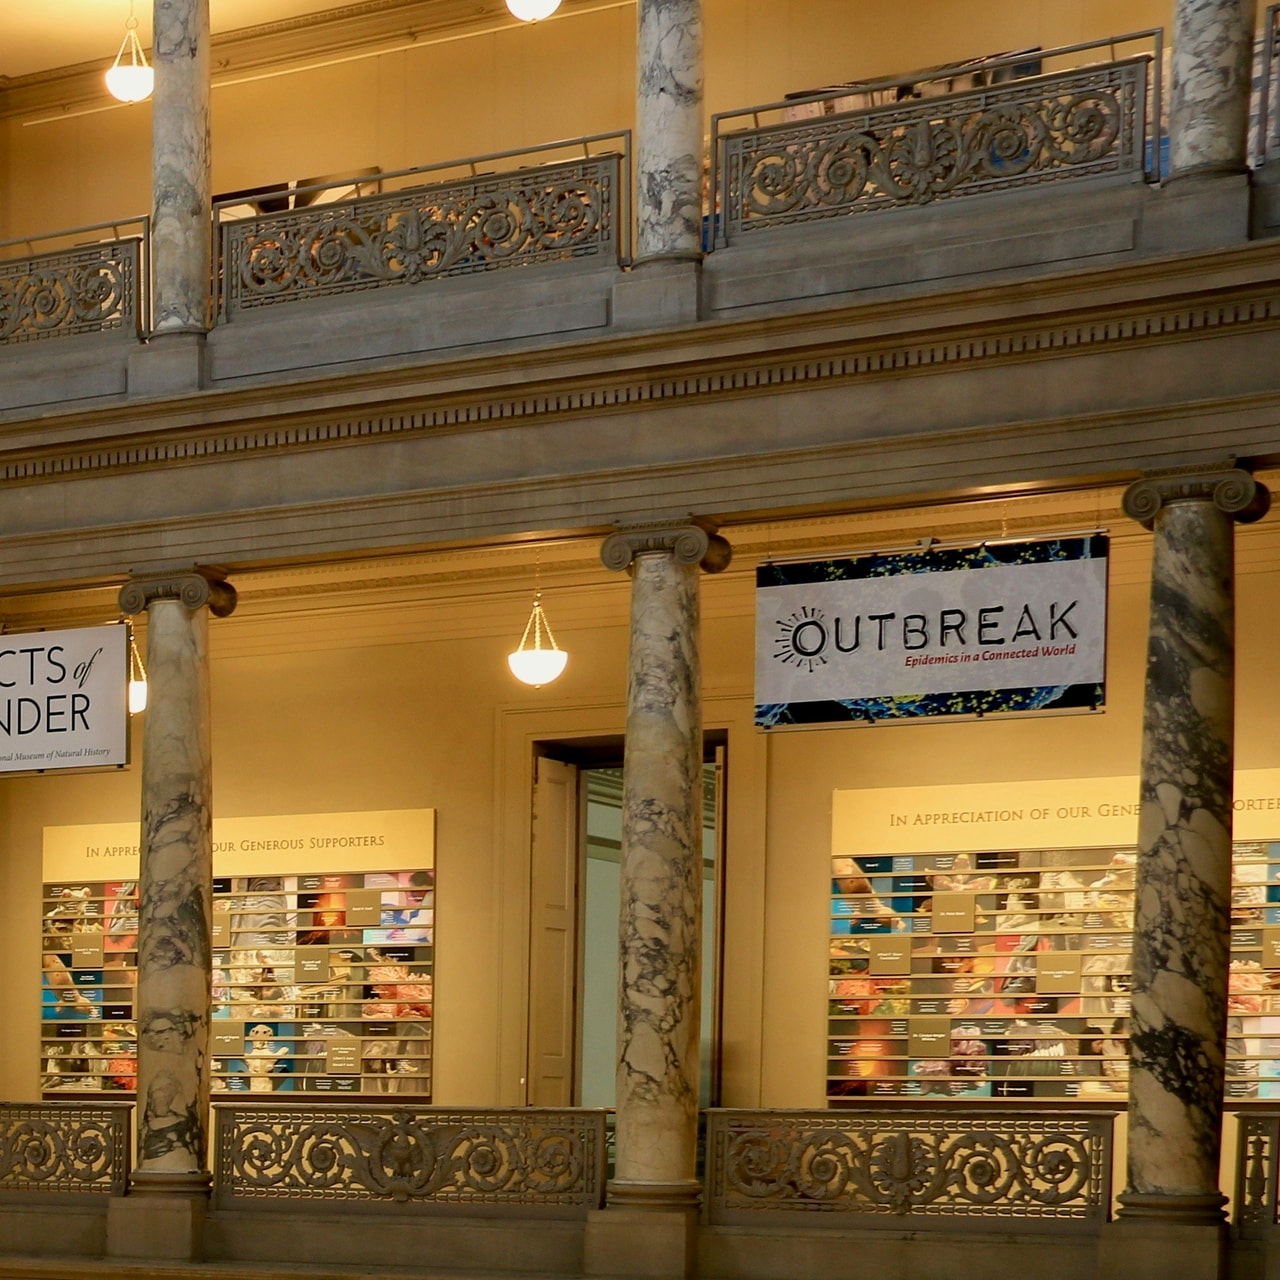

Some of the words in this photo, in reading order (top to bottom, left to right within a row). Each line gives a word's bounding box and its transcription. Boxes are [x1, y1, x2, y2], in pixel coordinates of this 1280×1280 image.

[790, 600, 1079, 657] OUTBREAK
[73, 647, 103, 689] of
[904, 654, 958, 668] Epidemics
[960, 653, 971, 663] in
[981, 646, 1039, 661] Connected
[1041, 643, 1076, 656] World
[14, 752, 45, 762] Museum
[45, 750, 55, 760] of
[54, 749, 83, 759] Natural
[84, 747, 111, 758] History
[889, 812, 910, 827] IN
[913, 808, 1024, 826] APPRECIATION
[1030, 807, 1050, 820] OF
[1056, 804, 1092, 819] OUR
[1098, 802, 1142, 817] GENE
[85, 845, 100, 858] IN
[240, 837, 305, 853] GENEROUS
[309, 834, 385, 849] SUPPORTERS
